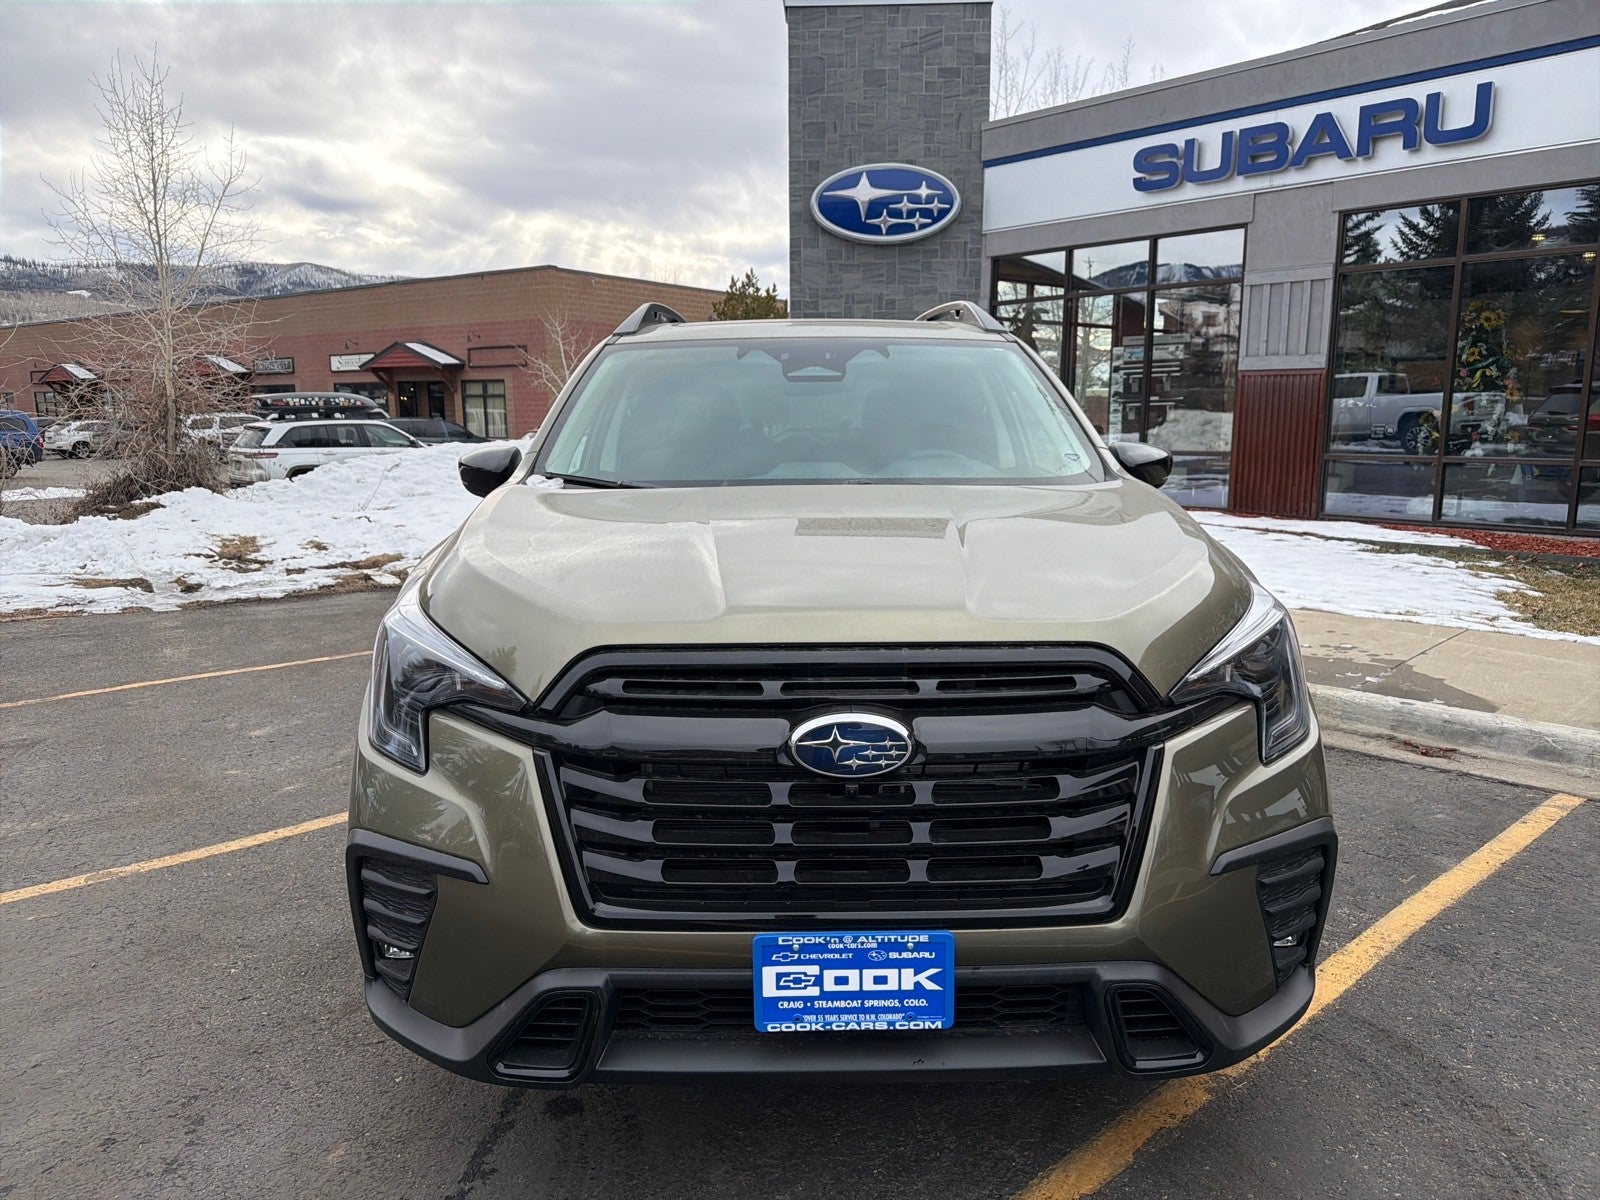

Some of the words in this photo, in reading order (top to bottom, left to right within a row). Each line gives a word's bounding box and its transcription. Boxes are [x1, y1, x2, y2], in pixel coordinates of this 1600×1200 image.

[1133, 81, 1495, 193] SUBARU
[843, 935, 853, 944] @
[857, 935, 929, 943] ALTITUDE
[762, 965, 943, 997] COOK
[778, 1001, 804, 1009] CRAIG
[814, 1000, 861, 1008] STEAMBOAT
[864, 1000, 902, 1008] SPRINGS,
[767, 1021, 942, 1032] COOK-CARS.COM
